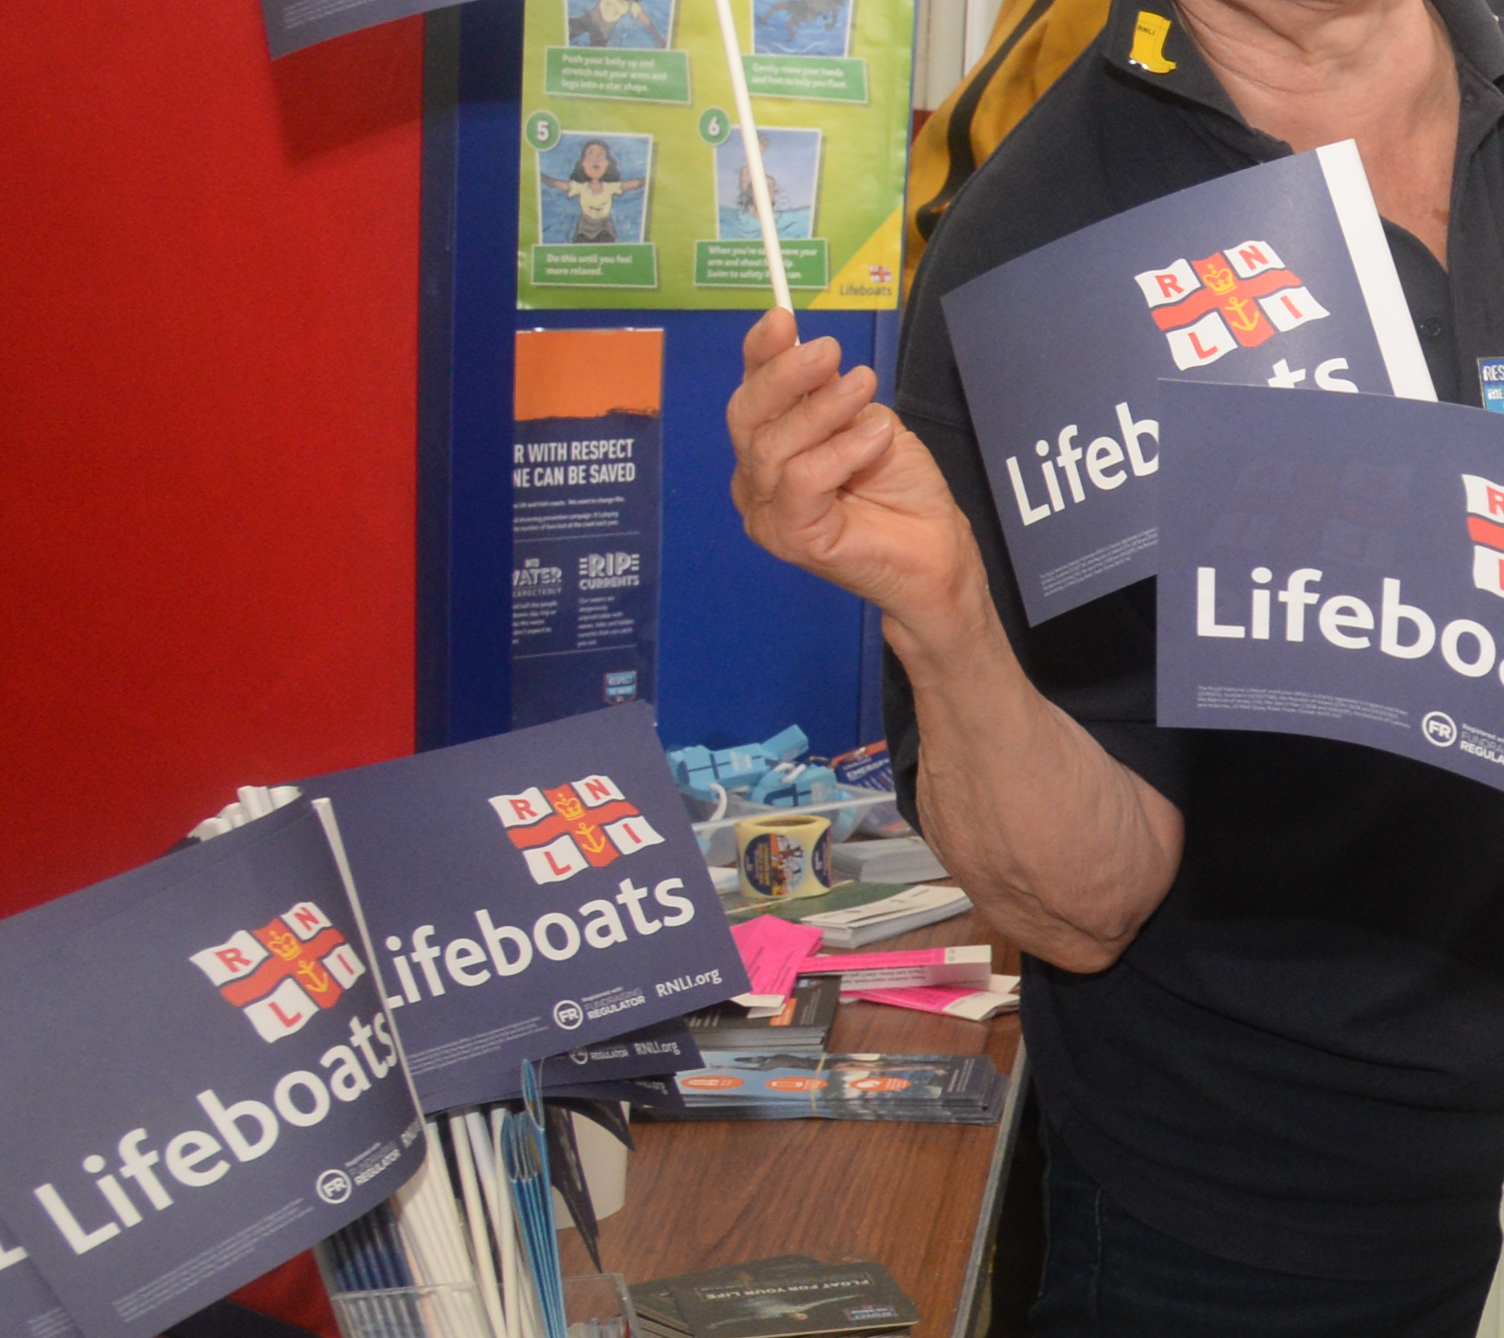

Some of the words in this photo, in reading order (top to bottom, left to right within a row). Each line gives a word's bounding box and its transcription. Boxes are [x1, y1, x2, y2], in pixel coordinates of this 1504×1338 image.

[537, 121, 549, 141] 5
[708, 116, 719, 136] 6
[839, 283, 892, 297] Lifeboats
[527, 442, 567, 462] WITH
[571, 438, 634, 461] RESPECT
[533, 466, 565, 487] CAN
[568, 465, 587, 485] BE
[590, 462, 636, 484] SAVED
[588, 553, 631, 577] RIP
[1429, 722, 1452, 740] FR
[656, 969, 722, 1000] RNLI.org
[587, 994, 645, 1021] REGULATOR
[635, 1038, 680, 1056] RNLI.org
[34, 1010, 399, 1256] Lifeboats
